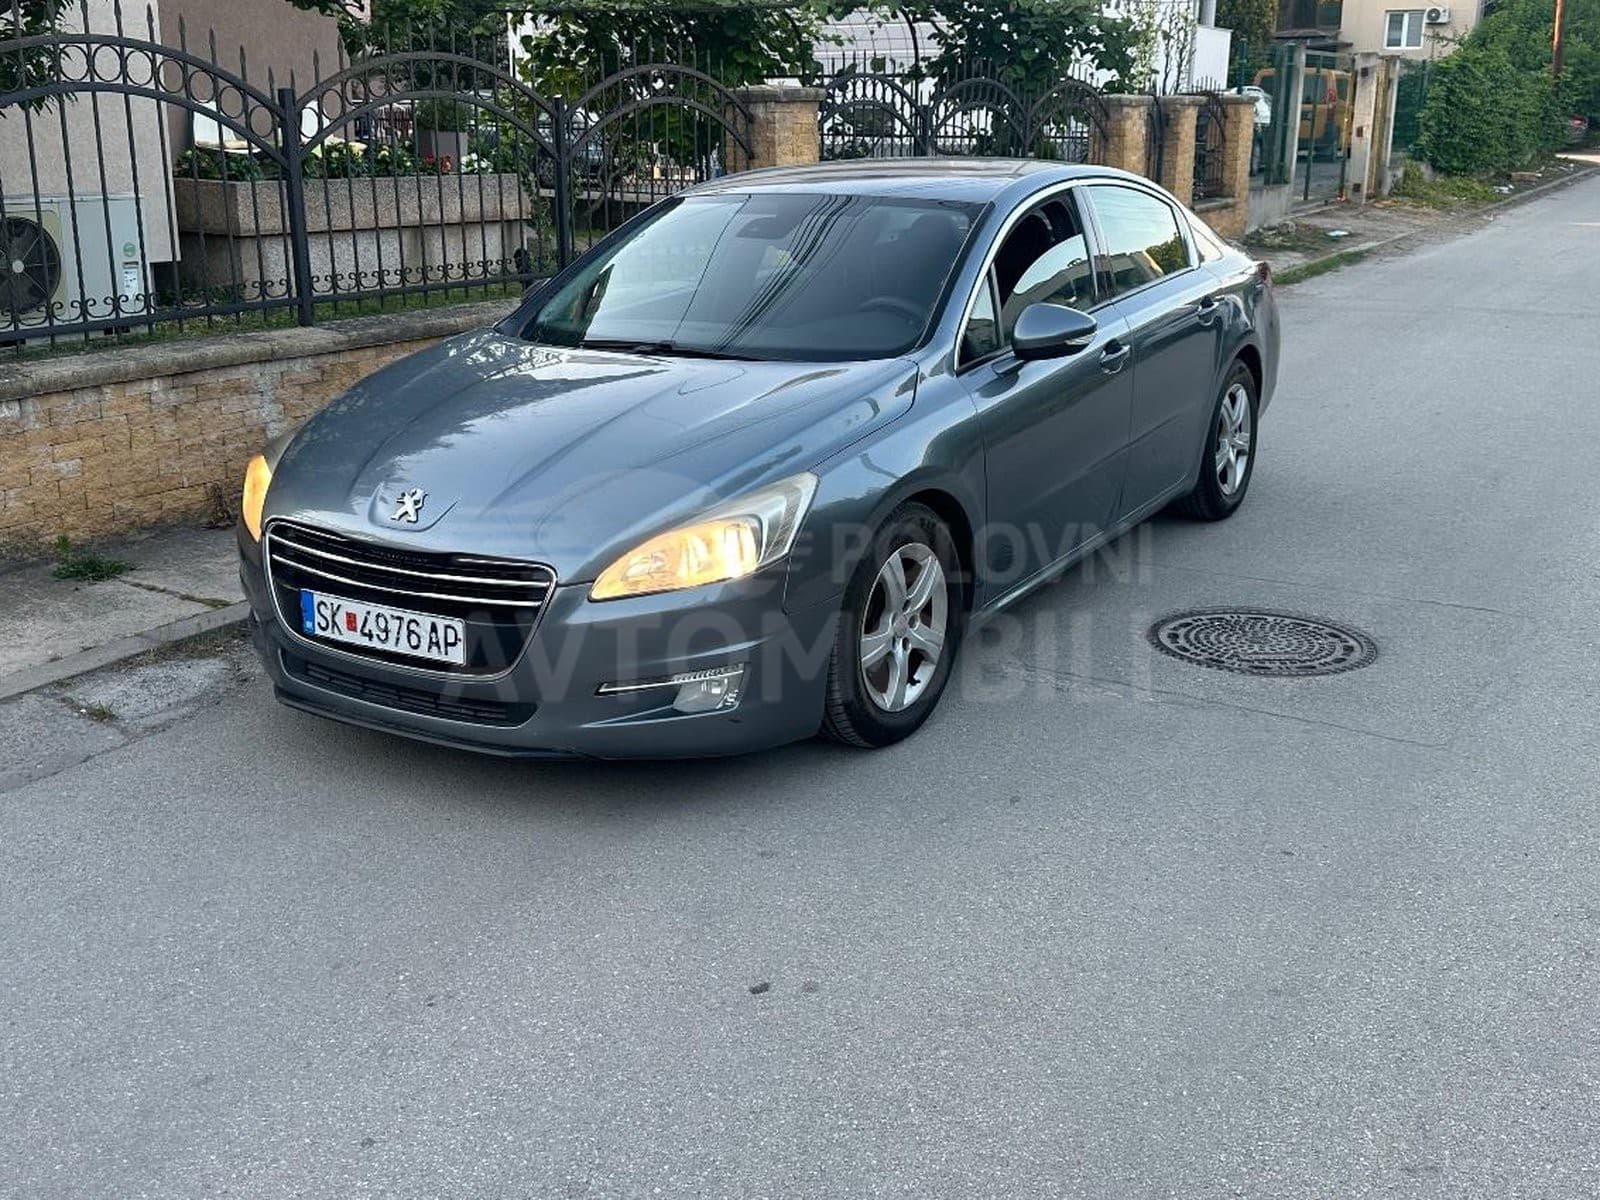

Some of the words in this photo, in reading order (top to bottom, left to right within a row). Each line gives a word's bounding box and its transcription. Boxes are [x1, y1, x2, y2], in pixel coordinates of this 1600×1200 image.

[316, 600, 344, 635] SK
[359, 610, 421, 651] 4976
[427, 620, 462, 656] AP
